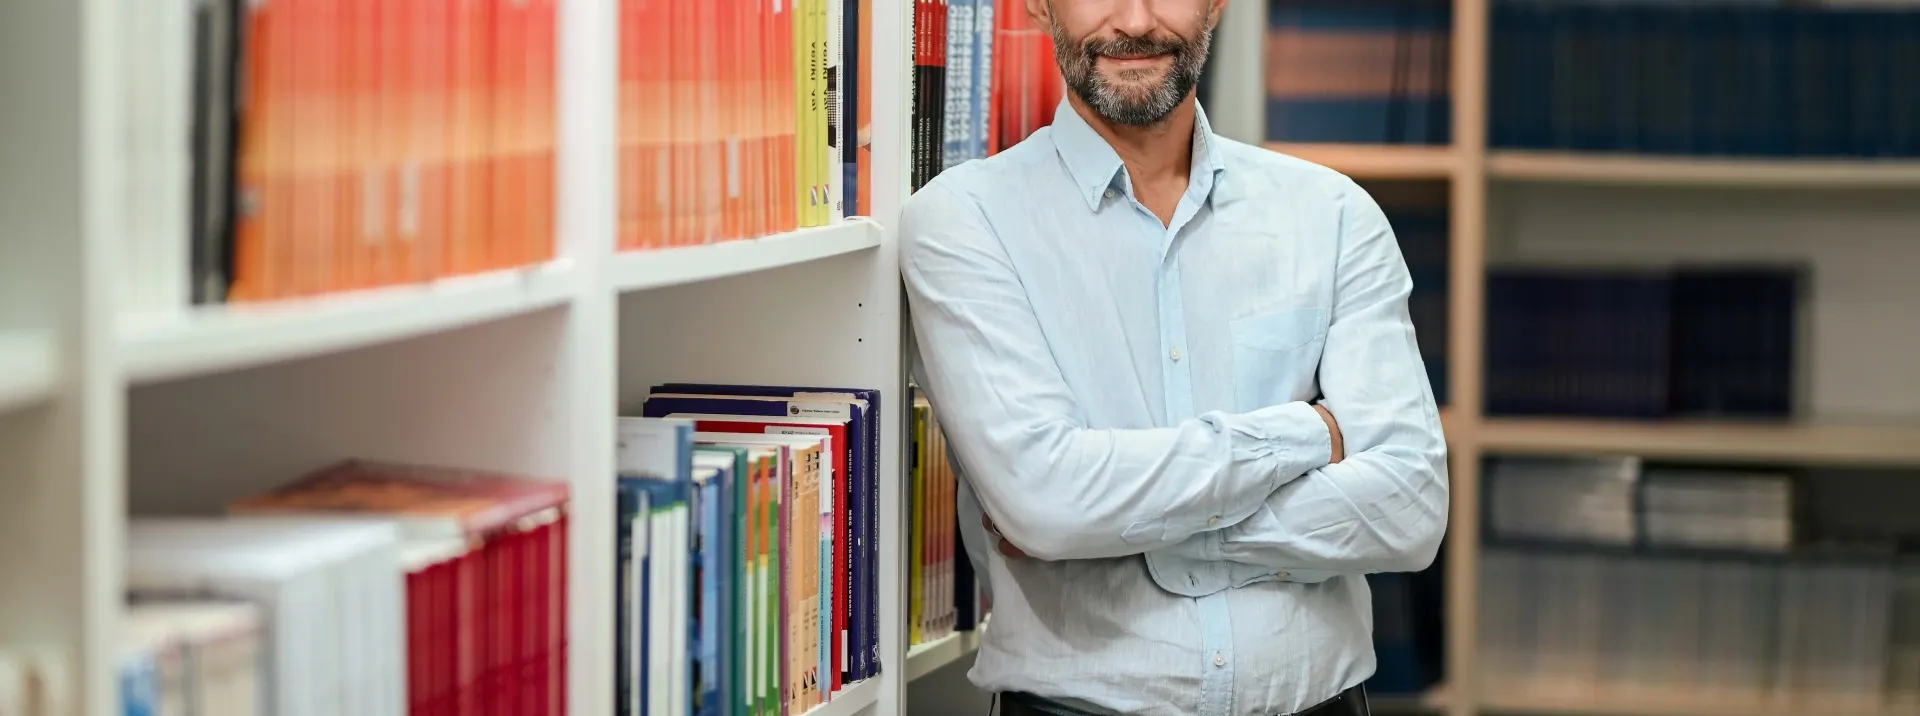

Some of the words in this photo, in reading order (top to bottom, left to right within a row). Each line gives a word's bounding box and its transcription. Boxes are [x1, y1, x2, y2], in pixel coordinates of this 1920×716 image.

[944, 3, 958, 144] ORGANIZACIJA
[961, 4, 974, 142] ORGANIZACIJA
[980, 4, 994, 142] ORGANIZACIJA
